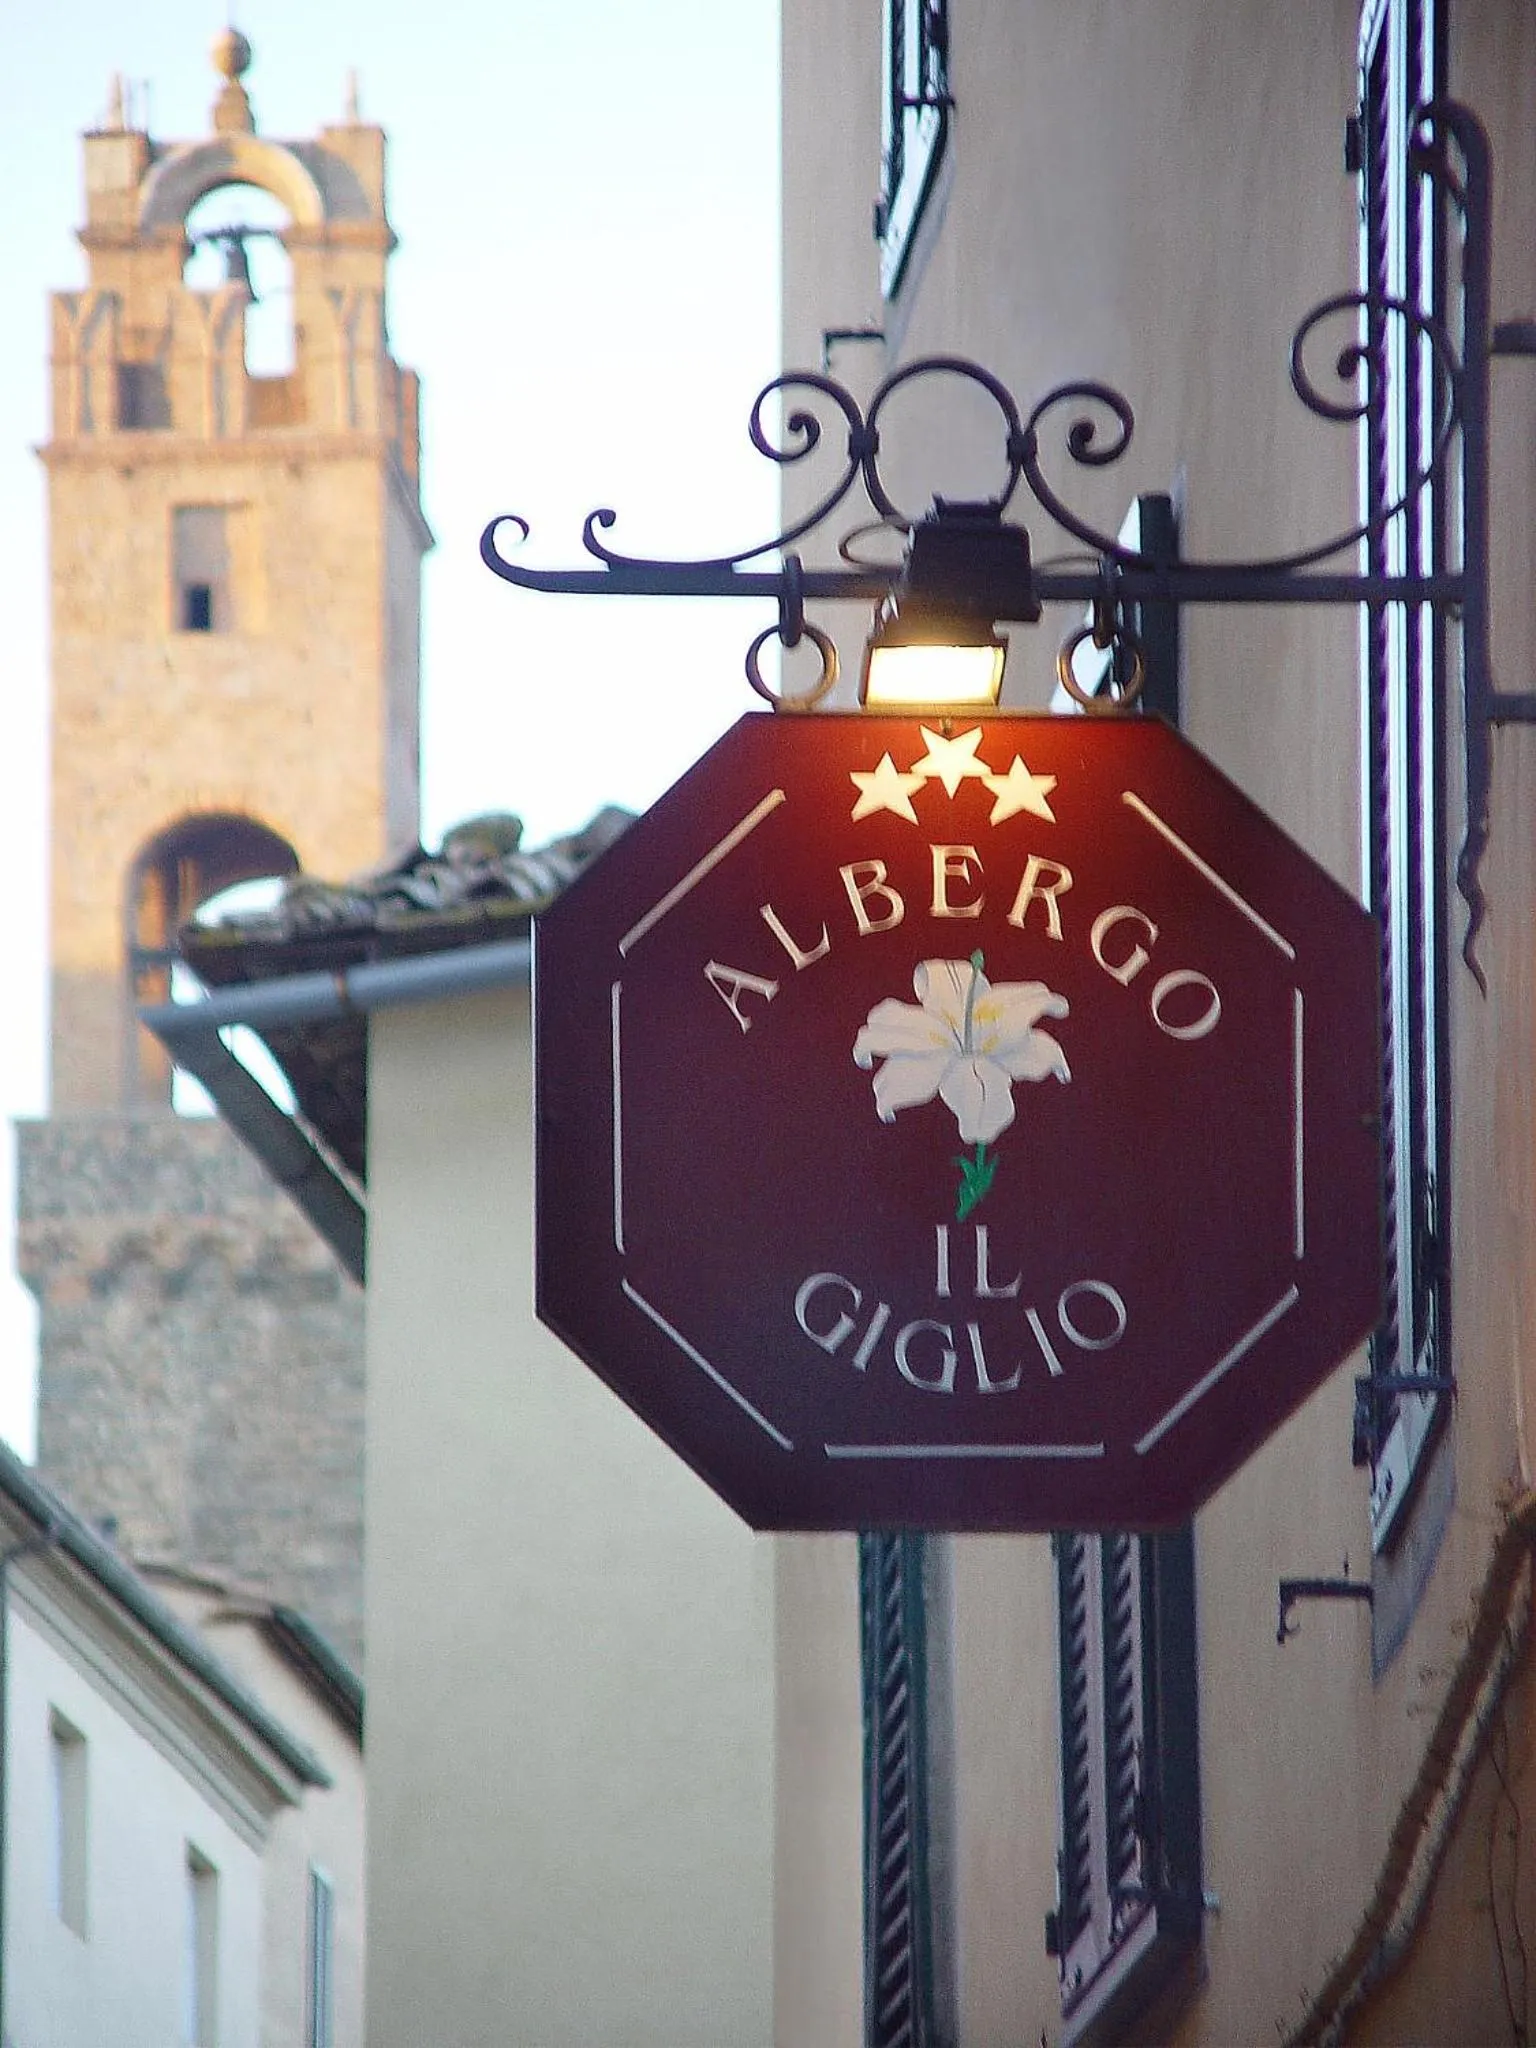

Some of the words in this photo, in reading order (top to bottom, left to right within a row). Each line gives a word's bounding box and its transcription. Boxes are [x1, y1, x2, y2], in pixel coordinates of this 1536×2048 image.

[703, 843, 1222, 1040] ALBERGO
[935, 1224, 1022, 1299] IL
[794, 1271, 1127, 1393] GIGLIO
